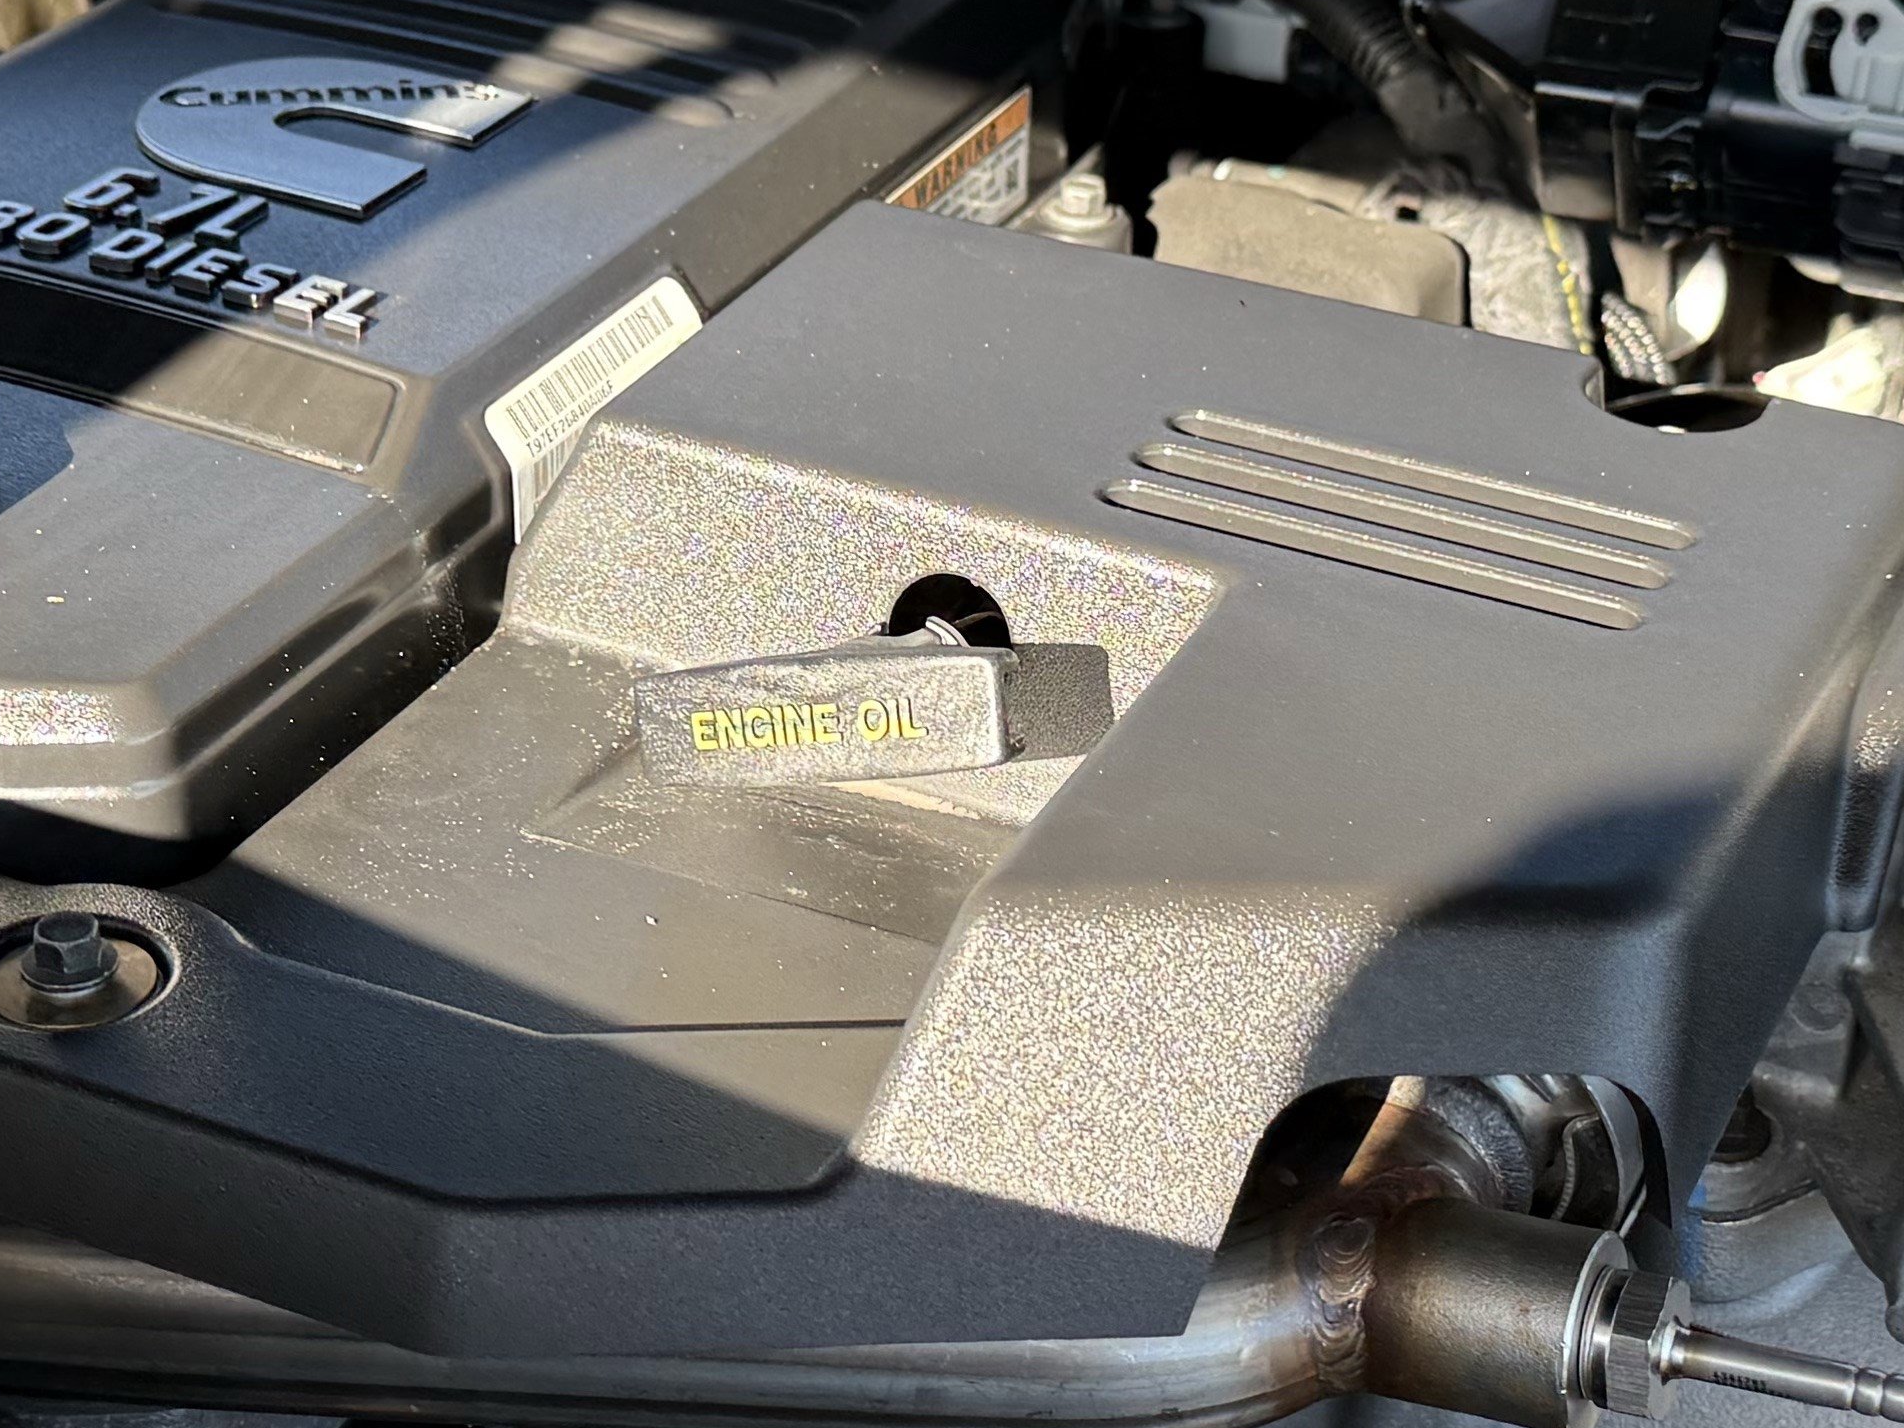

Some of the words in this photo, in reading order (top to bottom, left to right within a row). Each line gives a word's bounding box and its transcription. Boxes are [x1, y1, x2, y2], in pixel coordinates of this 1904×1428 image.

[158, 83, 500, 110] Cummins
[63, 166, 270, 248] 6.7L
[87, 224, 390, 339] DIESEL
[690, 703, 845, 753] ENGINE
[856, 698, 929, 743] OIL
